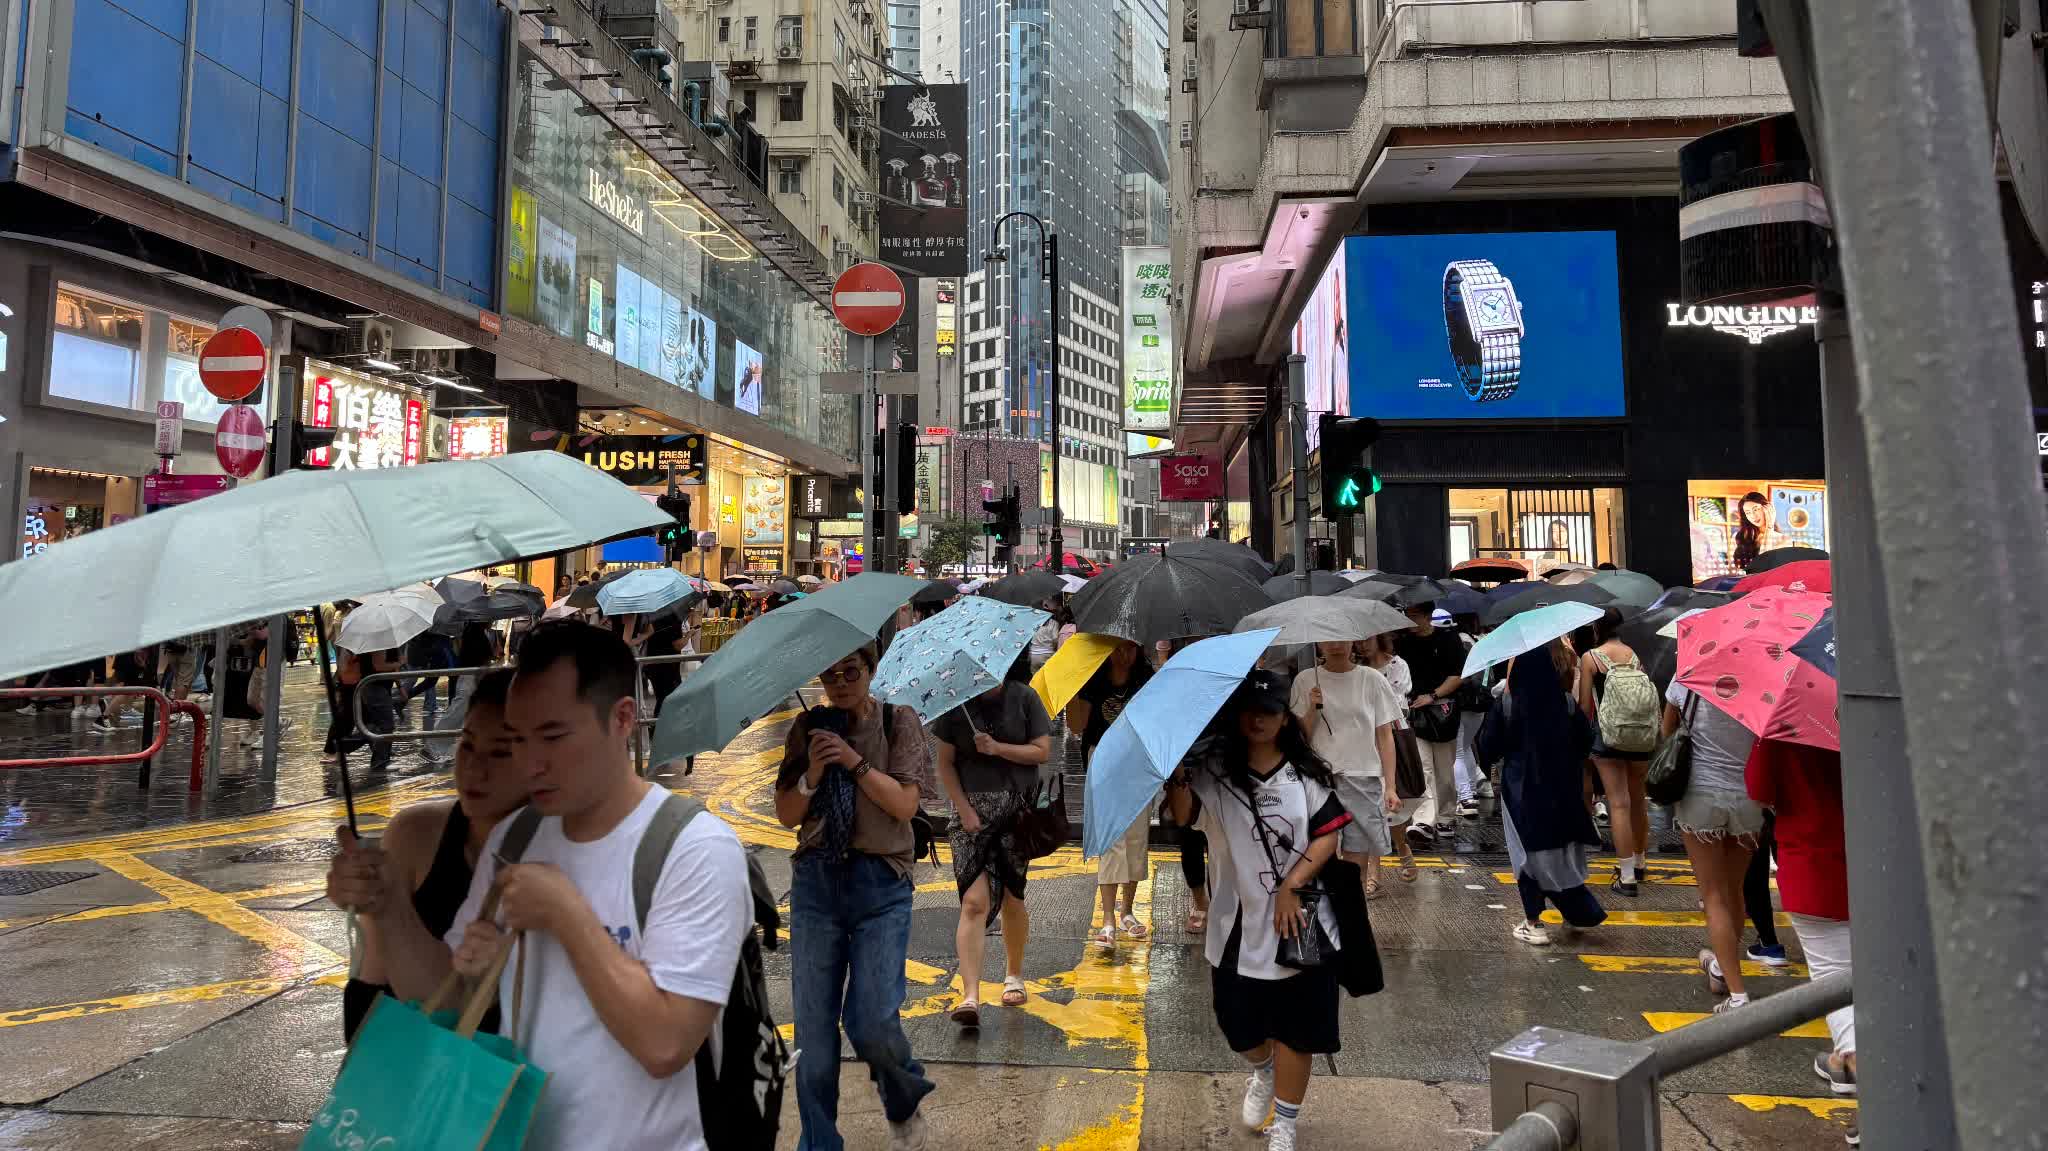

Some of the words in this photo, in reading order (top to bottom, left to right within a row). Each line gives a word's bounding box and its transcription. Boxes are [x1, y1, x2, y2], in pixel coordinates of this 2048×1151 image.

[1136, 264, 1171, 279] 啖啖
[1666, 304, 1819, 326] LONGINE
[584, 451, 654, 471] LUSH
